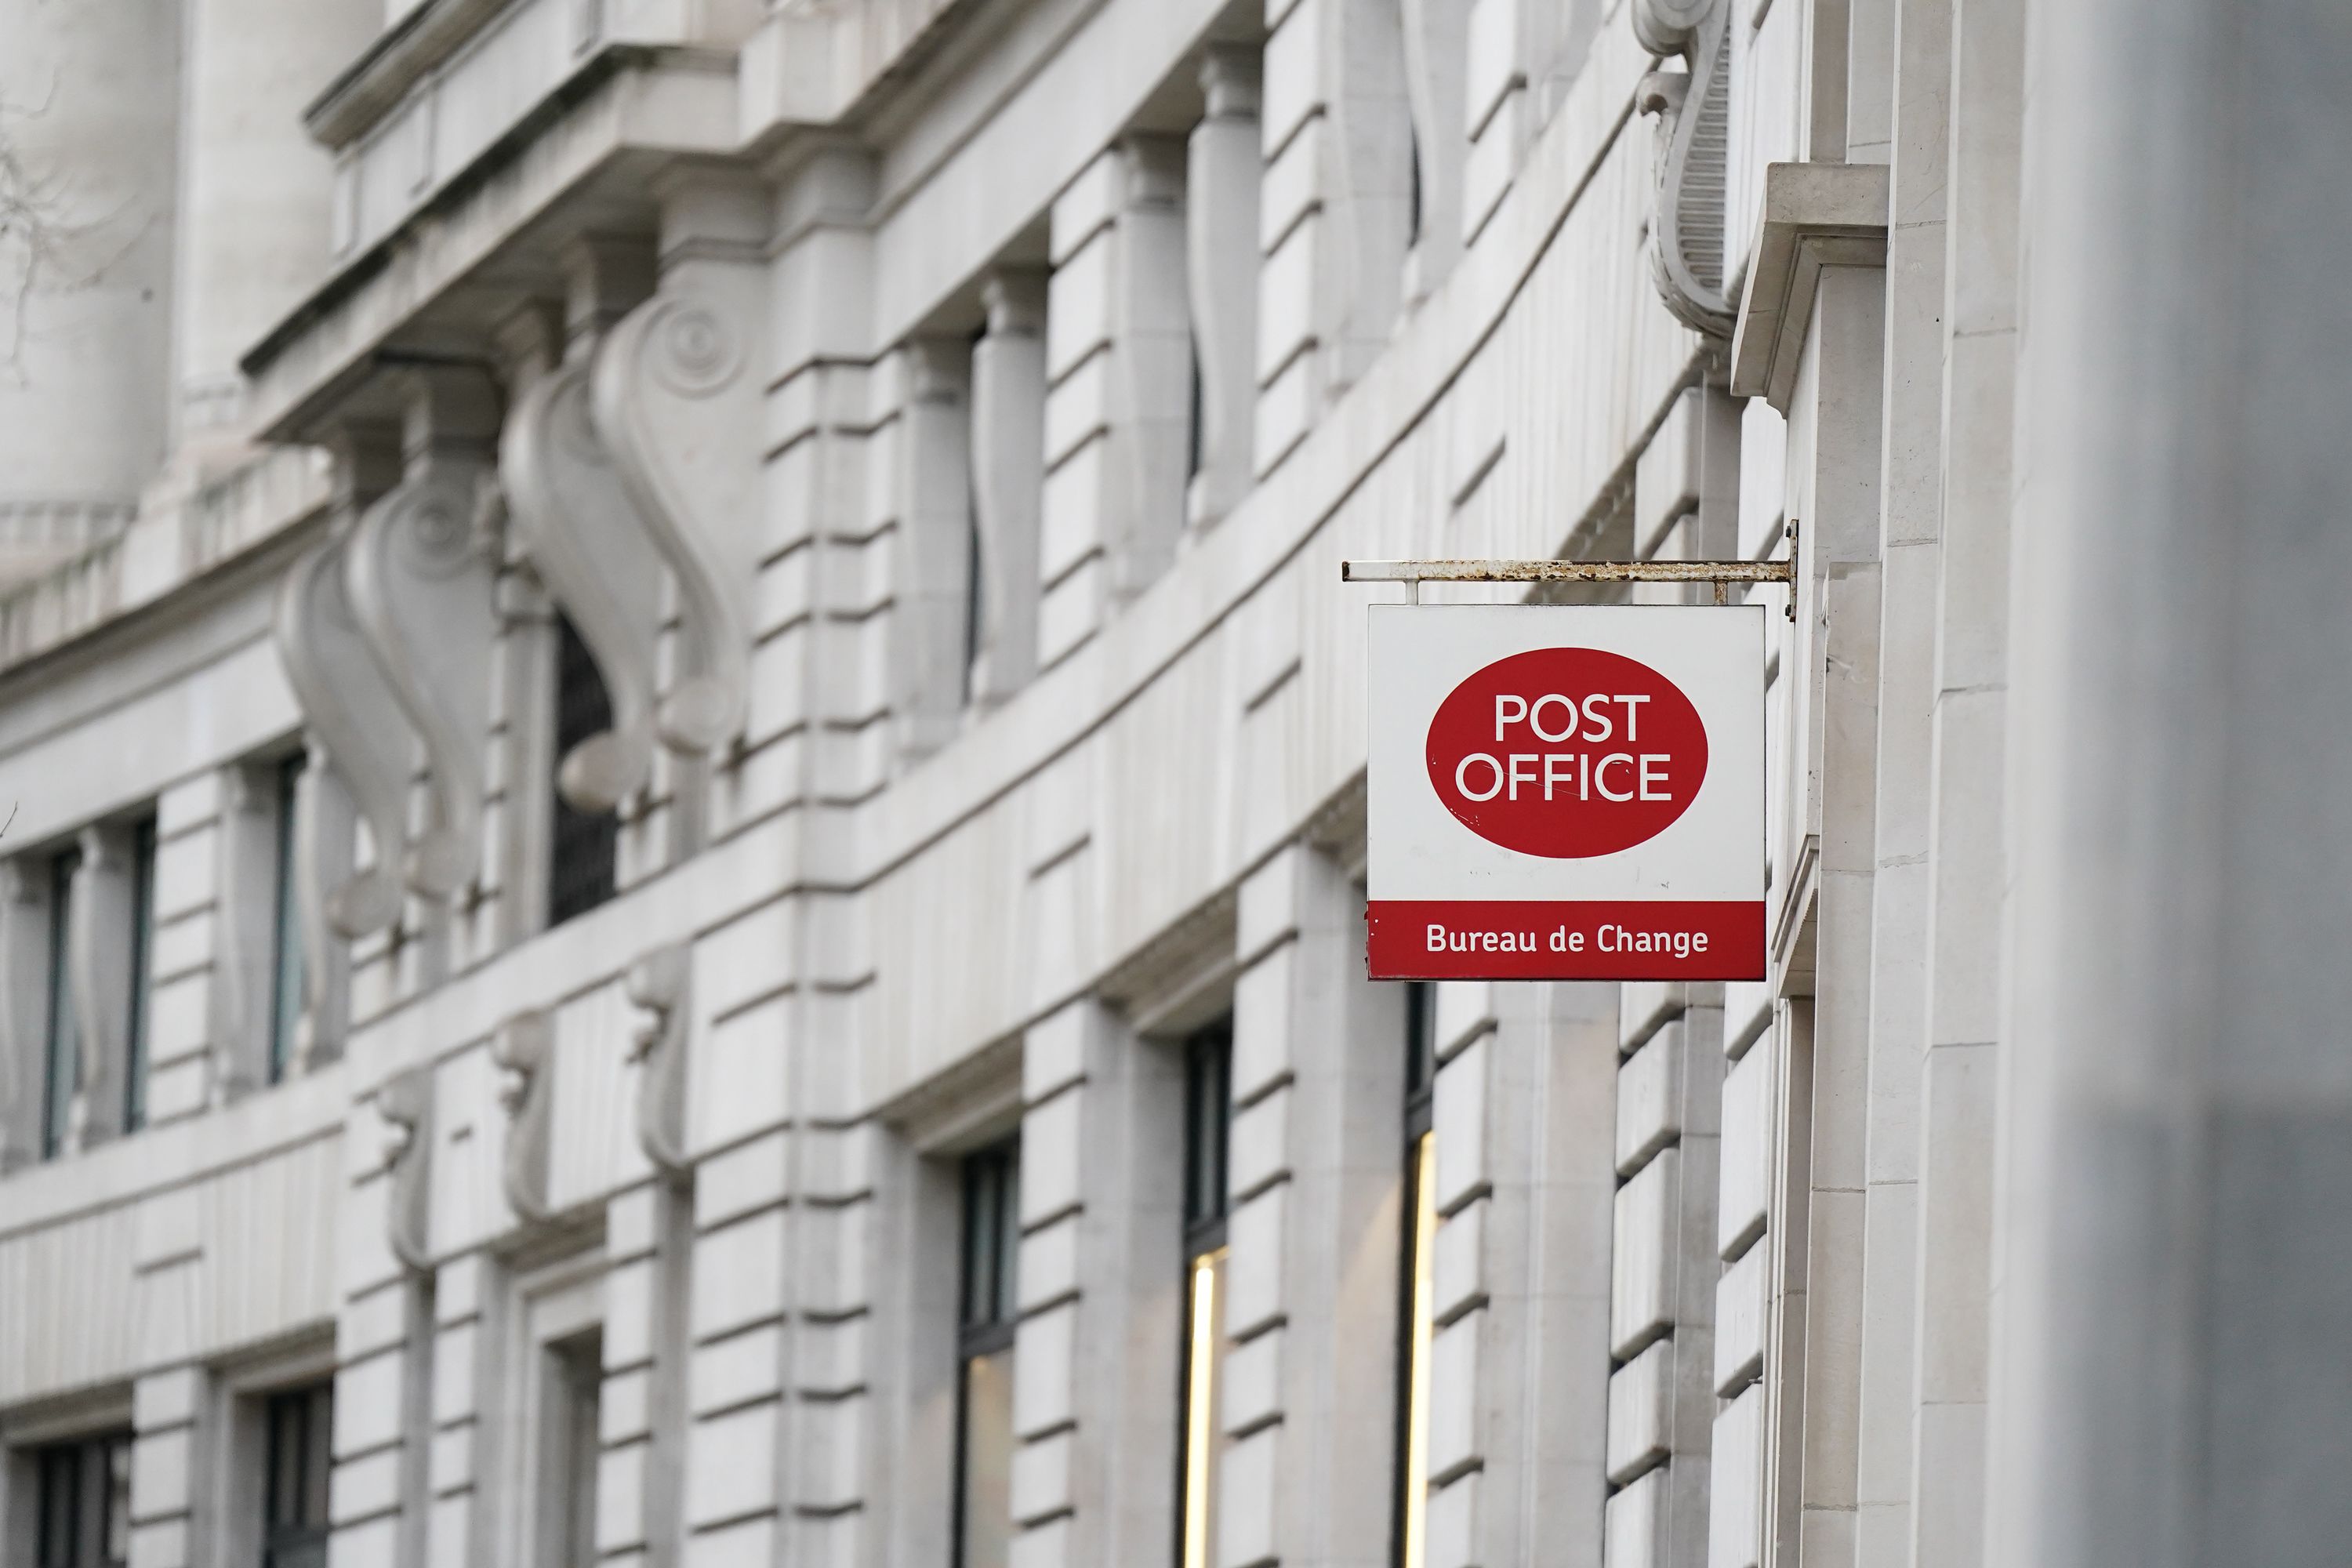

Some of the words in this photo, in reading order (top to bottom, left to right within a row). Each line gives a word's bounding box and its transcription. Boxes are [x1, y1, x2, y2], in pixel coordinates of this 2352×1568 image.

[1495, 693, 1650, 743] POST
[1454, 752, 1672, 802] OFFICE
[1427, 924, 1537, 953] Bureau
[1549, 924, 1584, 953] de
[1597, 924, 1708, 959] Change
